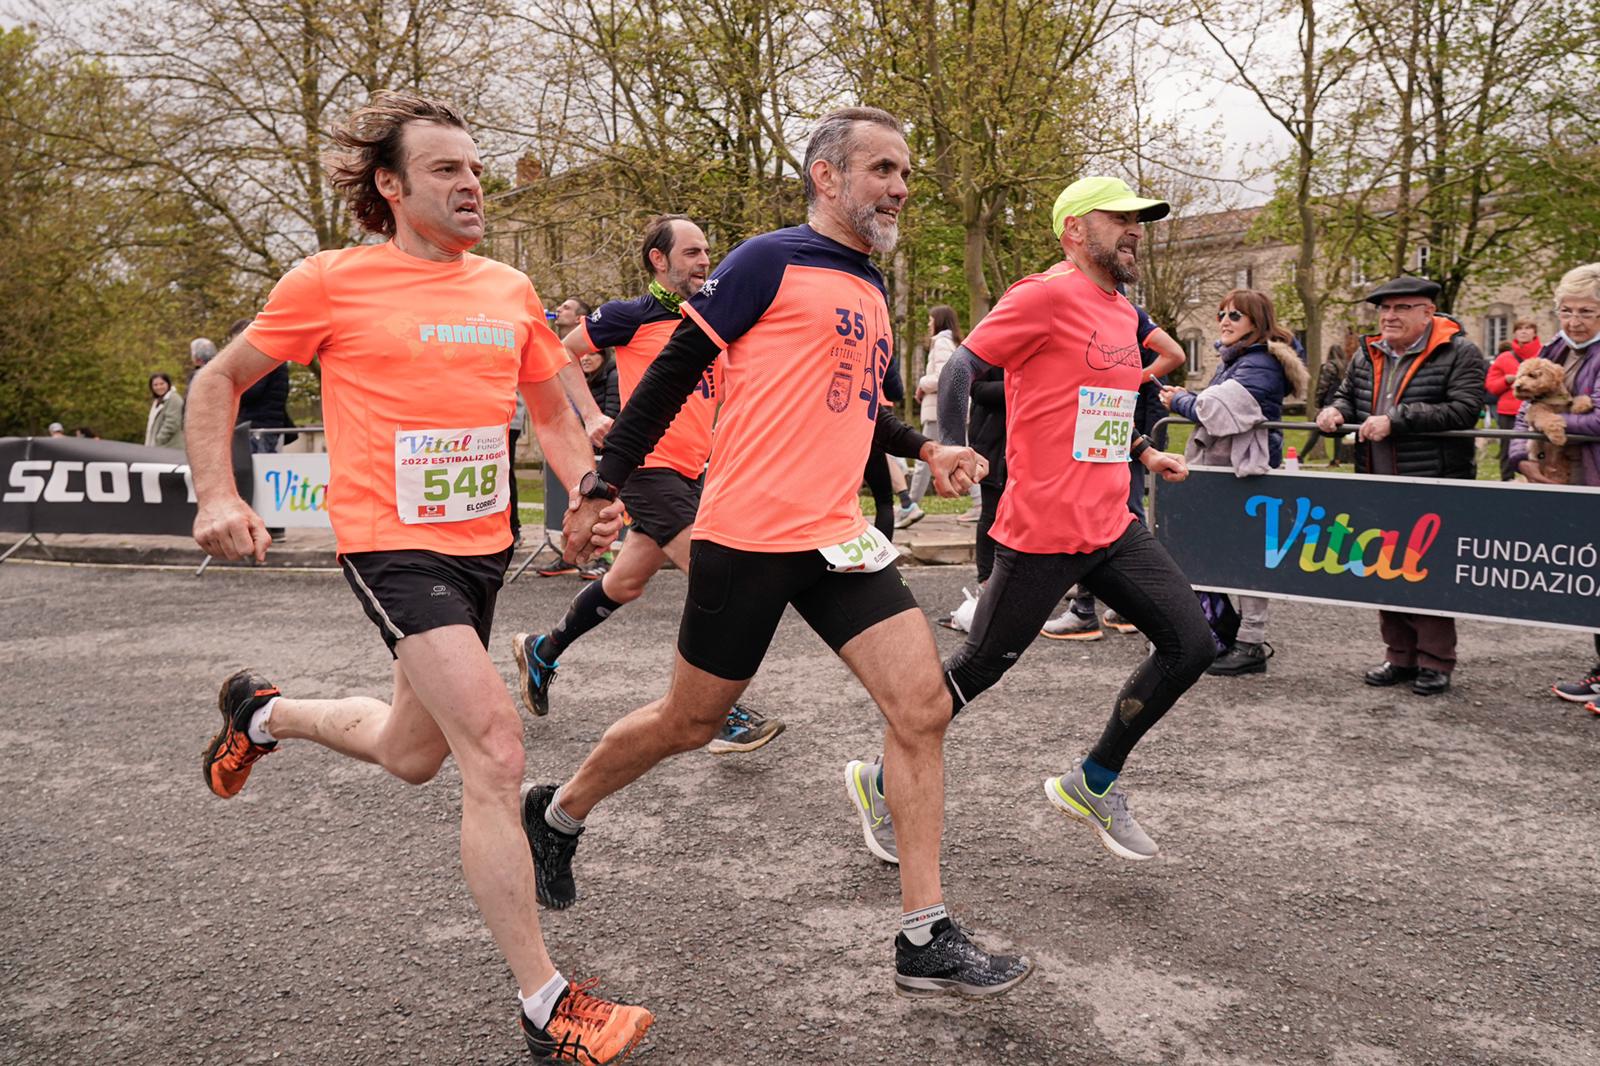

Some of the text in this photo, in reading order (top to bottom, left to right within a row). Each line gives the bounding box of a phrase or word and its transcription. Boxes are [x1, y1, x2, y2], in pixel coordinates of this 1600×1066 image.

[418, 324, 515, 349] FAMOUS
[835, 307, 865, 341] 35
[1081, 408, 1101, 416] 2022
[1086, 391, 1123, 408] Vital
[398, 434, 472, 454] Vital
[1093, 419, 1129, 446] 458
[401, 458, 429, 466] 2022
[431, 454, 484, 465] ESTIBALIZ
[264, 469, 330, 512] Vita
[424, 464, 498, 502] 548
[466, 504, 475, 512] EL
[475, 499, 496, 510] CORREO
[1244, 494, 1441, 583] Vital
